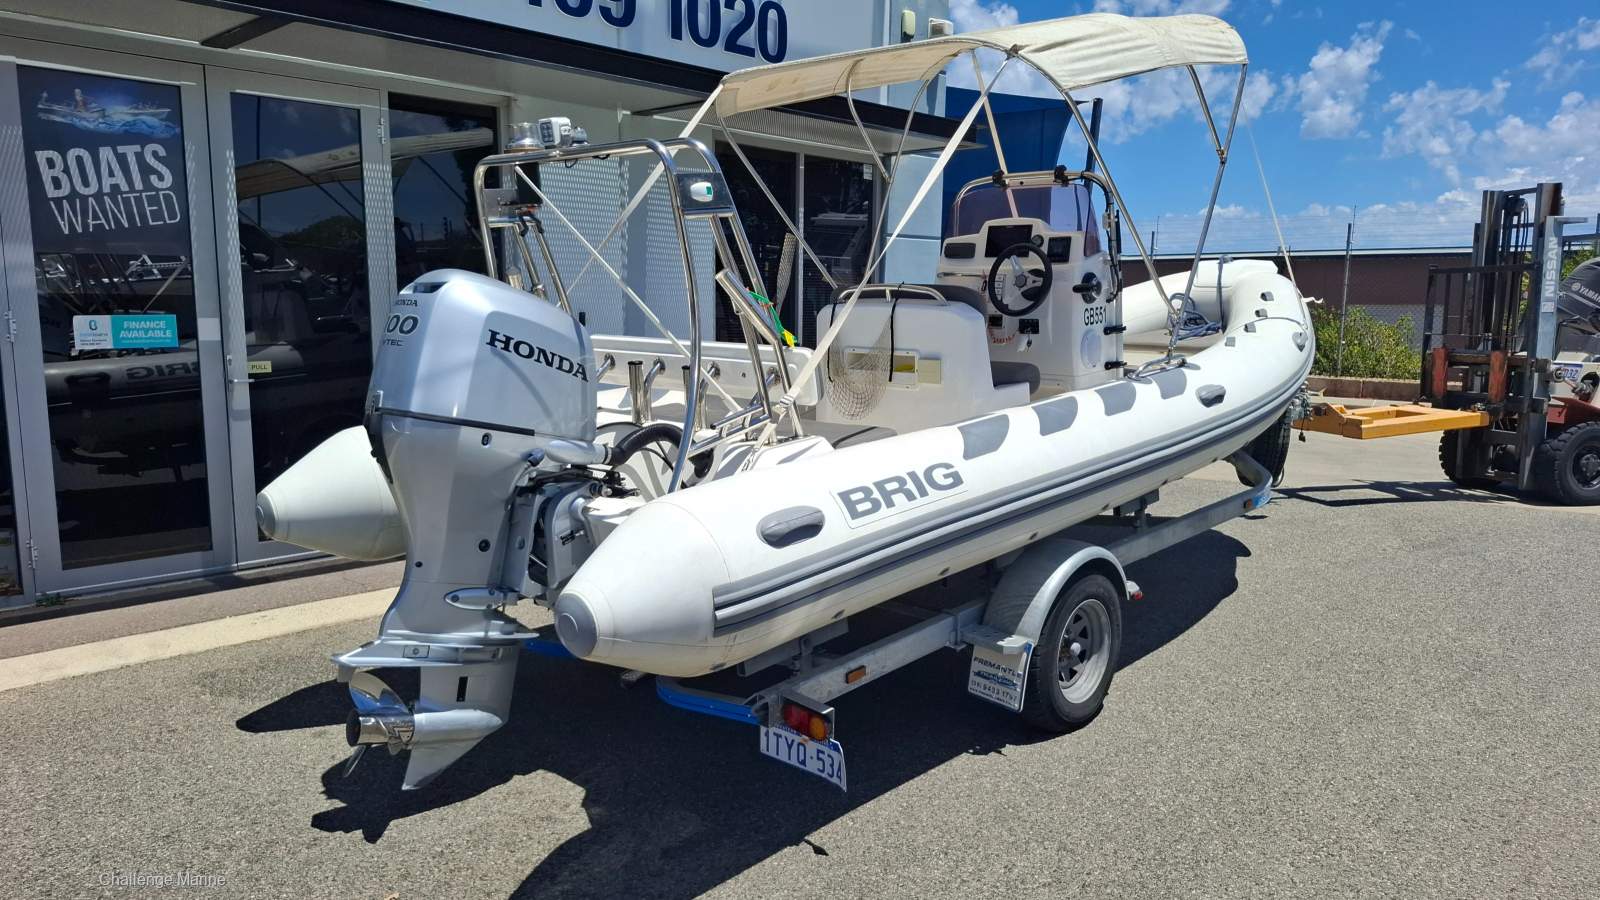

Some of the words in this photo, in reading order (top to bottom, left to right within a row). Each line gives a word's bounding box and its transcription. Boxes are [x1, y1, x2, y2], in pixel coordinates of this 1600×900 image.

[670, 0, 788, 63] 1020
[35, 144, 173, 198] BOATS
[50, 190, 181, 235] WANTED
[1544, 236, 1559, 298] NISSAN
[120, 329, 172, 338] AVAILABLE
[123, 320, 166, 329] FINANCE
[385, 314, 419, 334] 00
[1084, 306, 1107, 326] GB551
[486, 328, 589, 383] HONDA
[837, 462, 965, 521] BRIG
